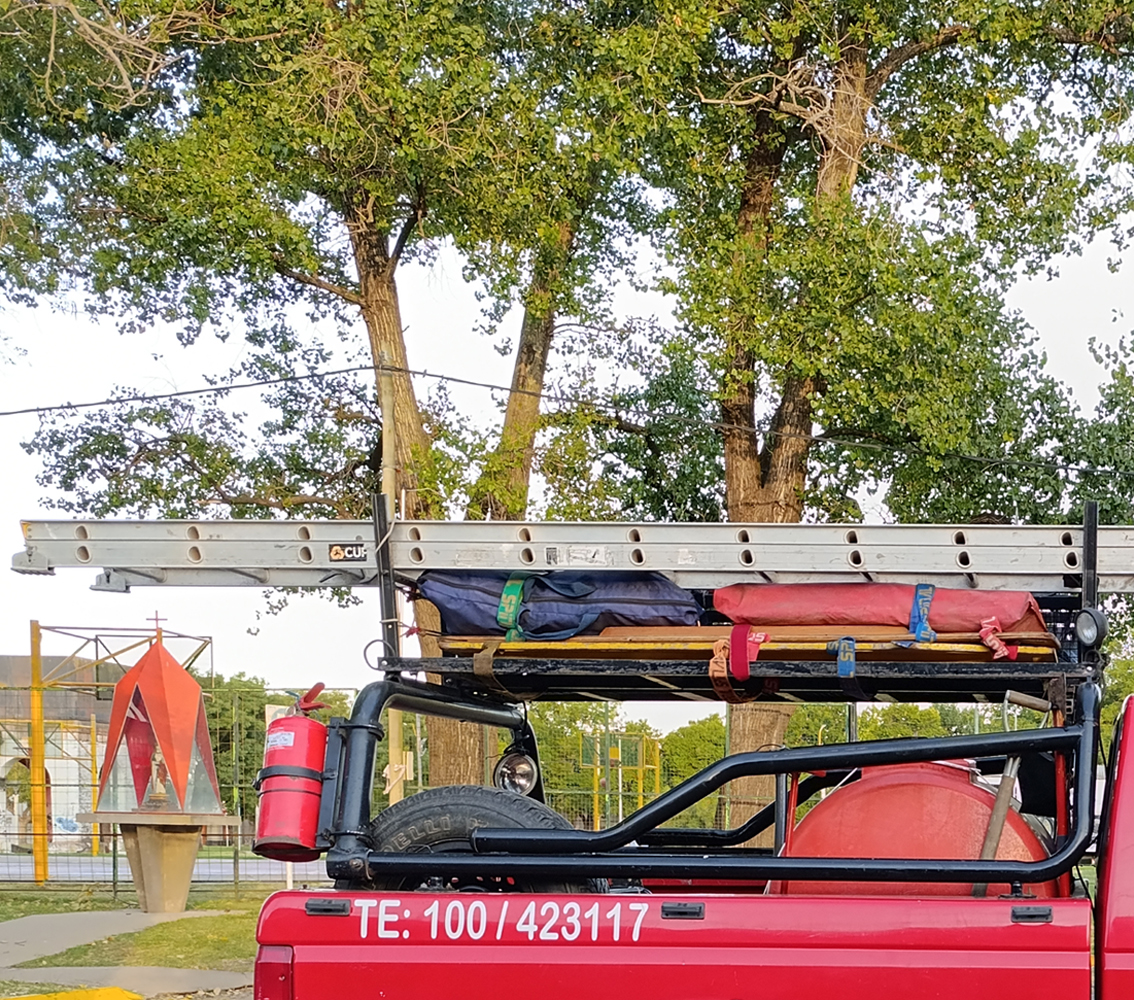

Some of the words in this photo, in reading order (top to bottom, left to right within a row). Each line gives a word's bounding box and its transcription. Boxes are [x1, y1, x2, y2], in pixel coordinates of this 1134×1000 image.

[354, 898, 411, 939] TE:
[423, 900, 487, 940] 100
[495, 900, 509, 940] /
[516, 901, 649, 942] 423117
